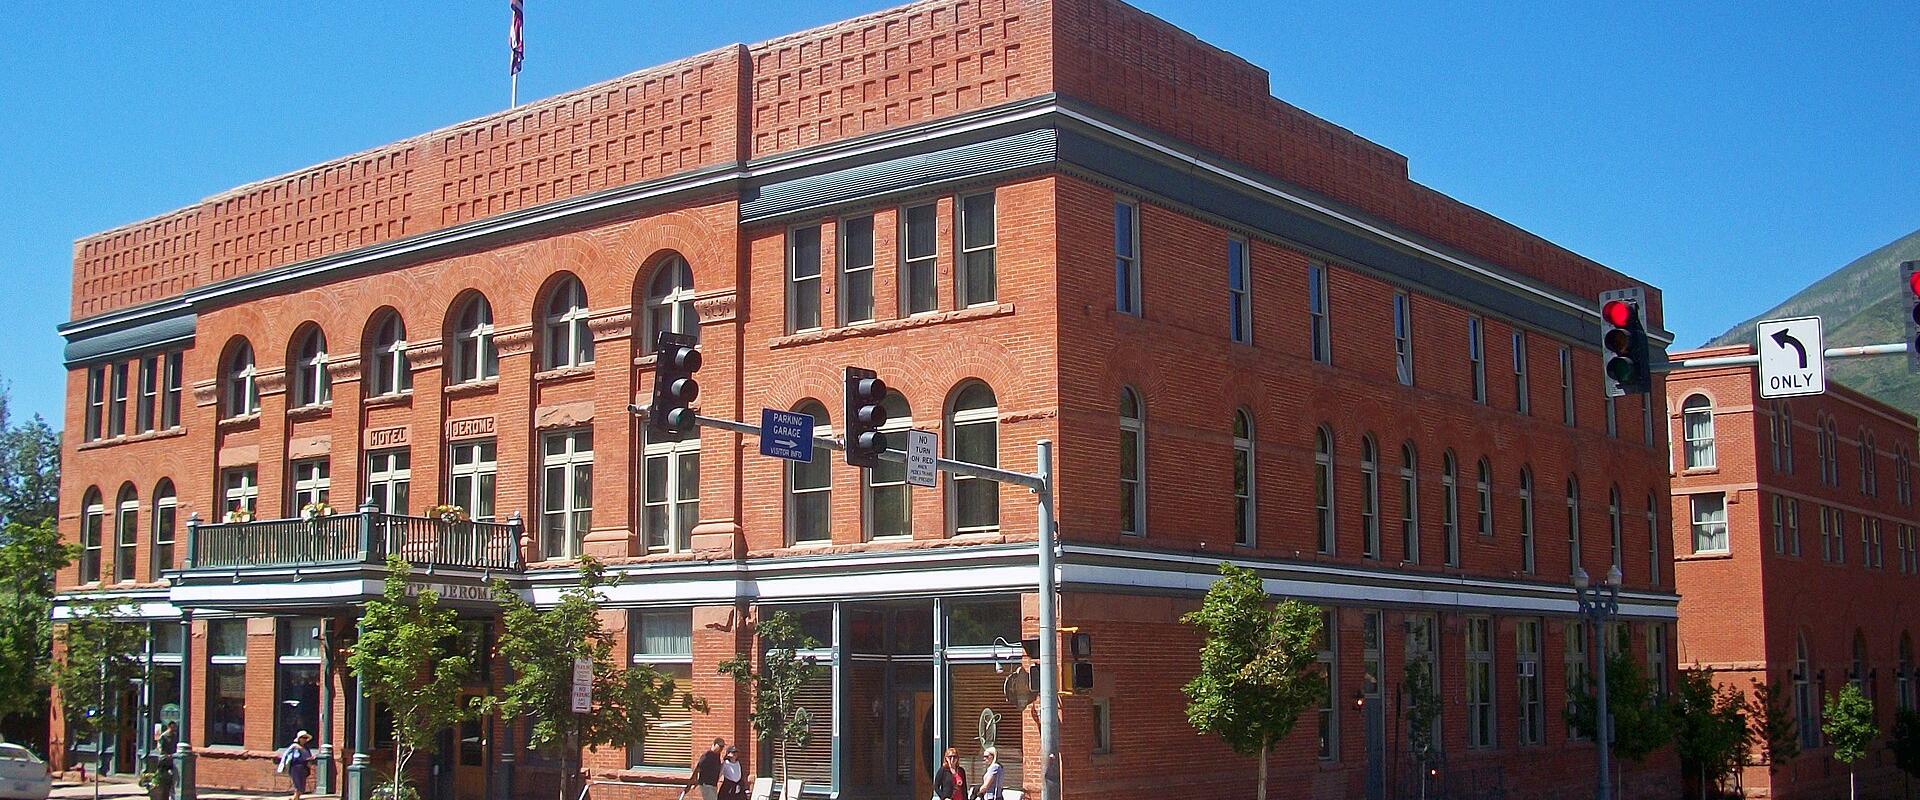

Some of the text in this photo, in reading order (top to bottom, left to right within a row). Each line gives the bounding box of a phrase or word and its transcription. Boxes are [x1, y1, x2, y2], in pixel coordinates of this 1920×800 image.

[1770, 373, 1813, 390] ONLY
[773, 413, 802, 426] PARKING
[371, 417, 494, 446] HOTEL JEROME
[773, 425, 801, 438] GARAGE
[918, 435, 928, 445] NO
[770, 447, 790, 456] VISITOR
[916, 446, 931, 455] TURN
[911, 455, 934, 465] ON RED
